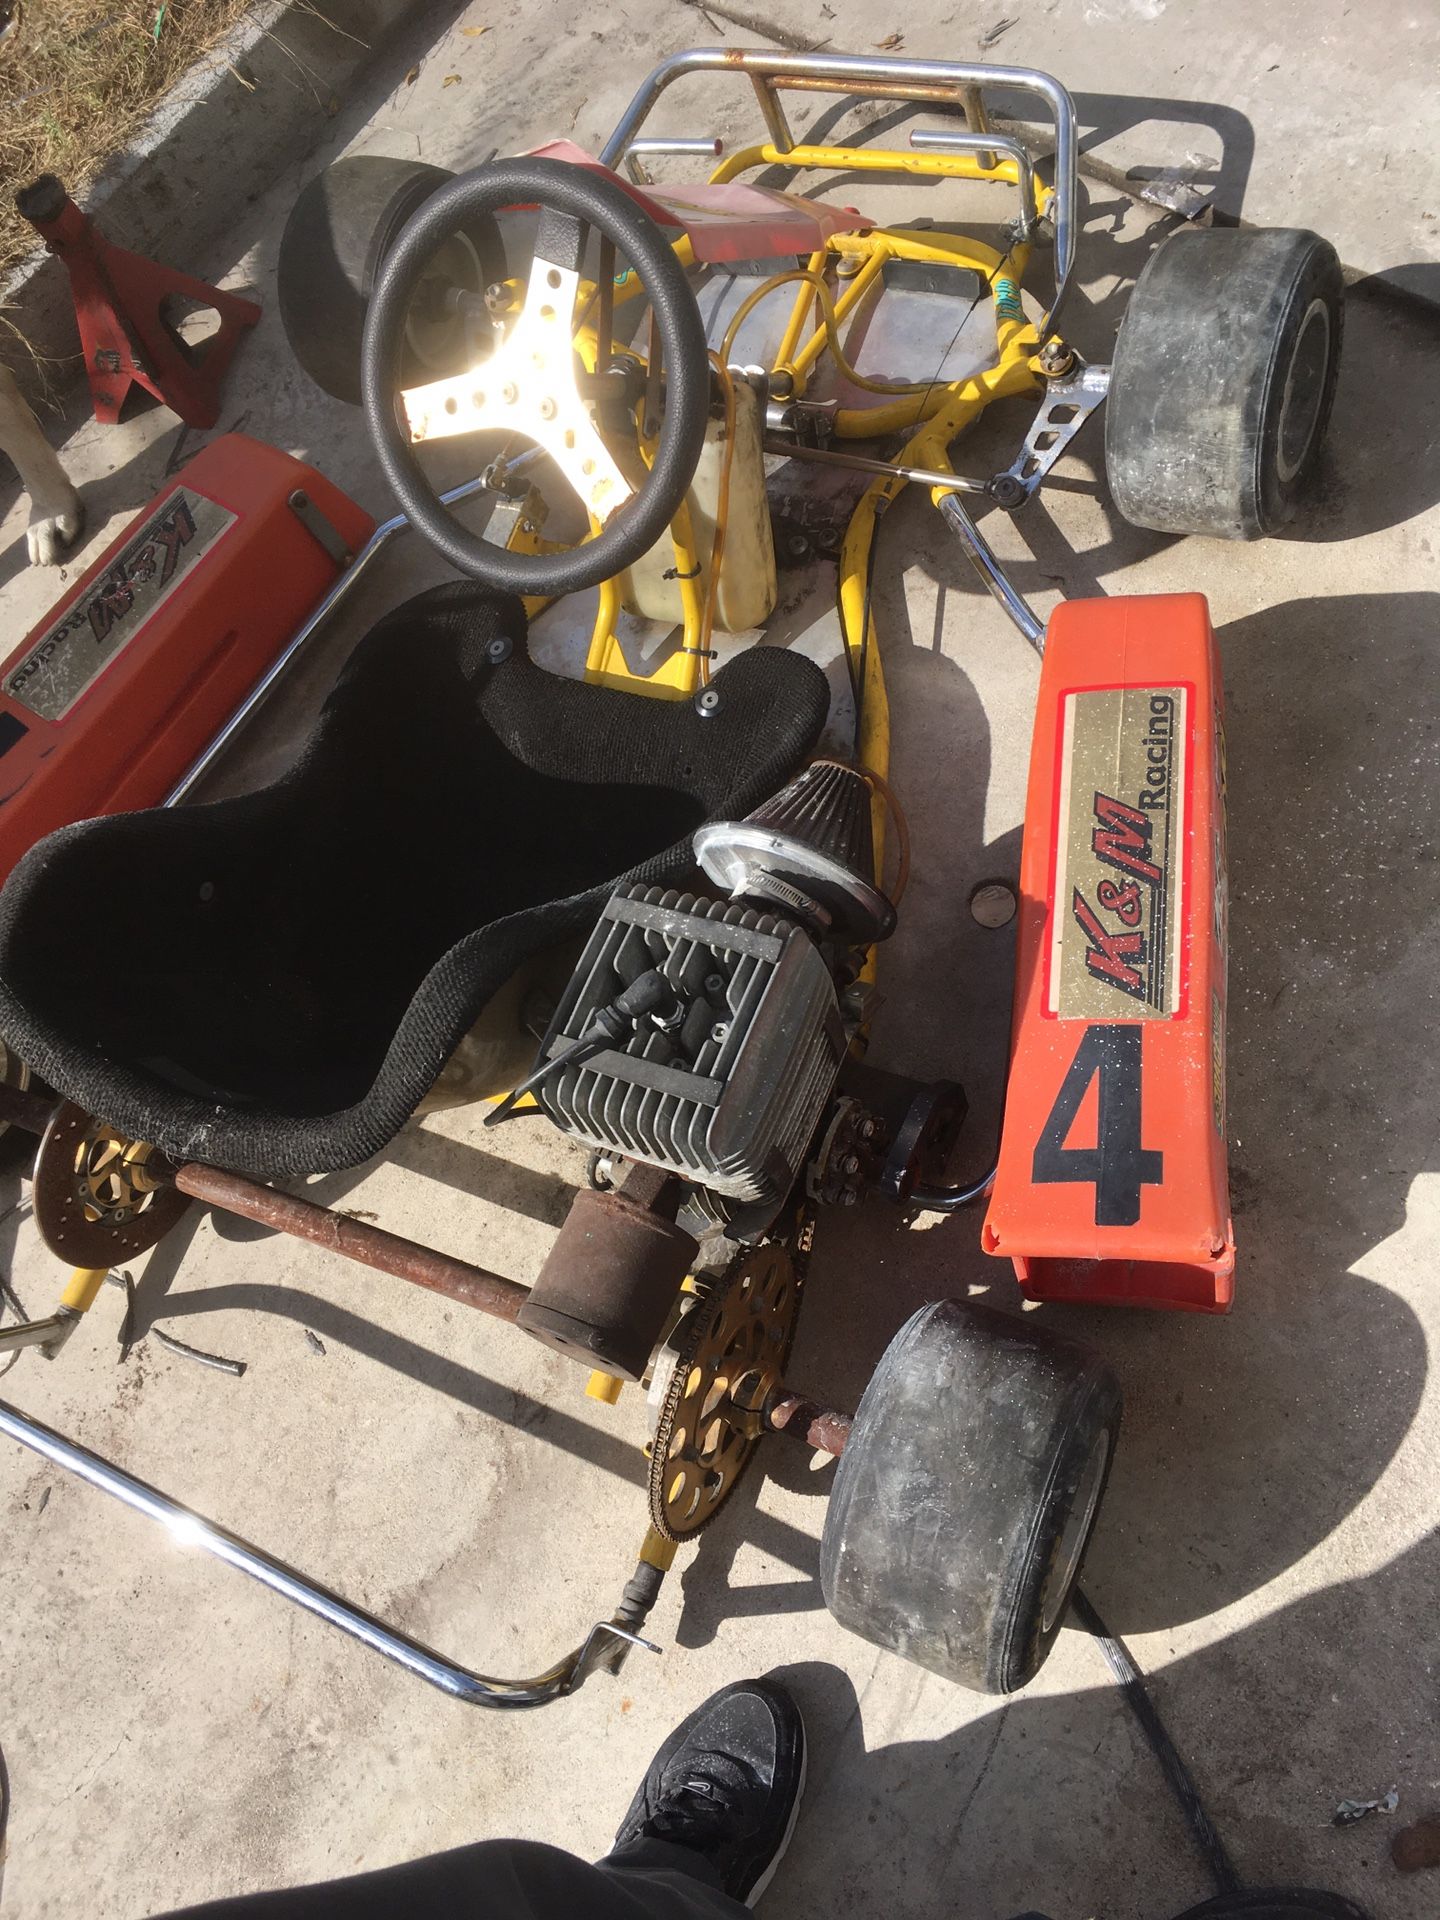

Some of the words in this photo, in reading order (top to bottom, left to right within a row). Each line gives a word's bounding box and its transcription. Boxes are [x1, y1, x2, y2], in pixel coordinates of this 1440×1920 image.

[9, 609, 88, 692] Racing
[86, 495, 198, 644] K&M
[1073, 791, 1163, 1003] K&M
[1138, 695, 1174, 809] Racing
[1031, 1024, 1164, 1226] 4
